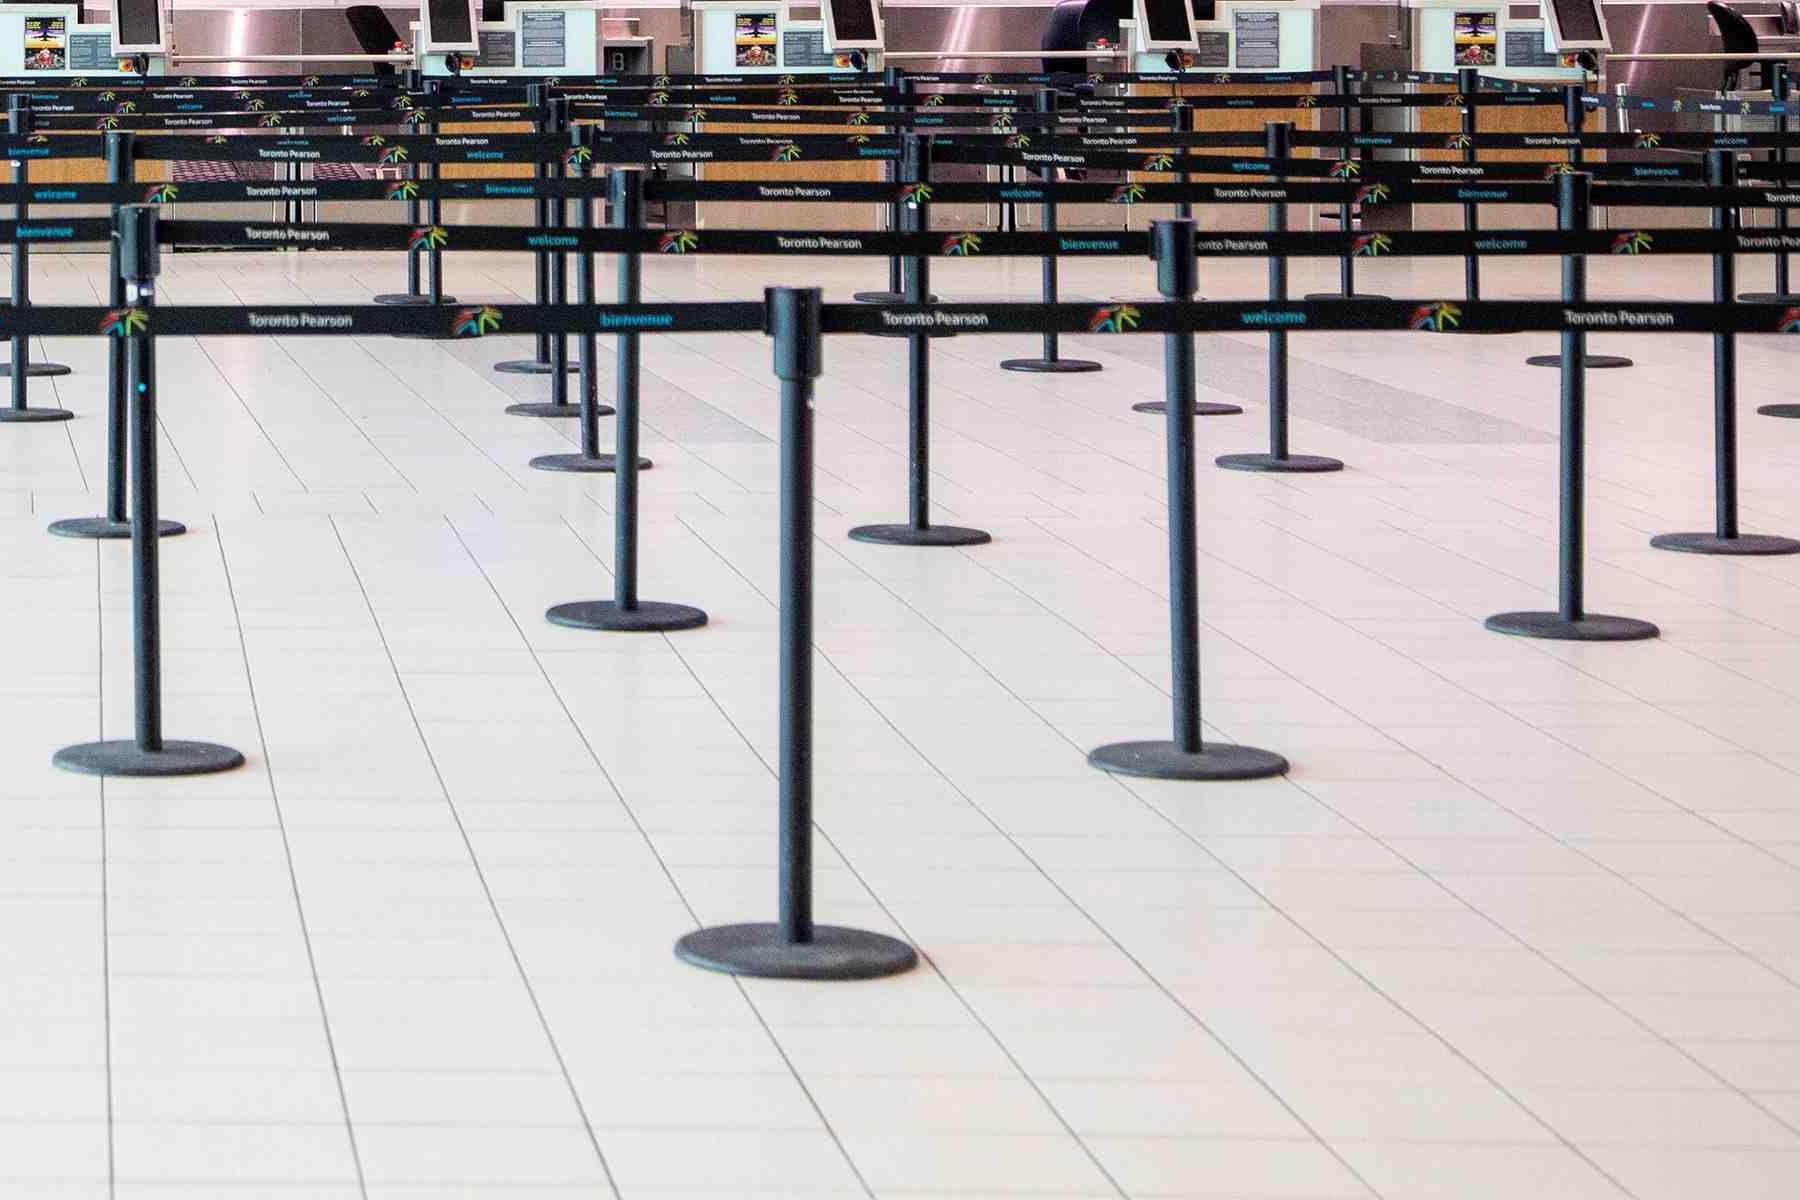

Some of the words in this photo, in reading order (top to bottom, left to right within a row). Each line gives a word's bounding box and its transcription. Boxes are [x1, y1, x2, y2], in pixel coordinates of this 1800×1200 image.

[436, 137, 461, 145] Toronto
[462, 137, 488, 145] Pearson
[1083, 137, 1109, 145] Toronto
[1110, 137, 1136, 145] Pearson
[1525, 137, 1551, 145] Toronto
[1552, 137, 1580, 145] Pearson
[259, 149, 288, 158] Toronto
[289, 149, 320, 158] Pearson
[651, 150, 681, 159] Toronto
[682, 150, 713, 159] Pearson
[1023, 153, 1052, 164] Toronto
[1053, 153, 1084, 164] Pearson
[1420, 166, 1451, 175] Toronto
[1452, 166, 1483, 175] Pearson
[246, 186, 280, 197] Toronto
[281, 186, 317, 197] Pearson
[486, 185, 534, 194] bienvenue
[760, 187, 794, 197] Toronto
[795, 187, 830, 197] Pearson
[1000, 189, 1043, 198] welcome
[1215, 188, 1249, 198] Toronto
[1250, 188, 1286, 198] Pearson
[246, 228, 286, 241] Toronto
[287, 228, 329, 241] Pearson
[528, 234, 578, 246] welcome
[778, 237, 818, 250] Toronto
[819, 237, 862, 250] Pearson
[1061, 239, 1119, 251] bienvenue
[1475, 238, 1527, 249] welcome
[1737, 237, 1778, 247] Toronto
[249, 314, 299, 328] Toronto
[300, 314, 352, 328] Pearson
[601, 312, 673, 326] bienvenue
[883, 312, 934, 326] Toronto
[935, 312, 988, 326] Pearson
[1241, 310, 1305, 323] welcome
[1564, 311, 1617, 325] Toronto
[1618, 311, 1674, 325] Pearson
